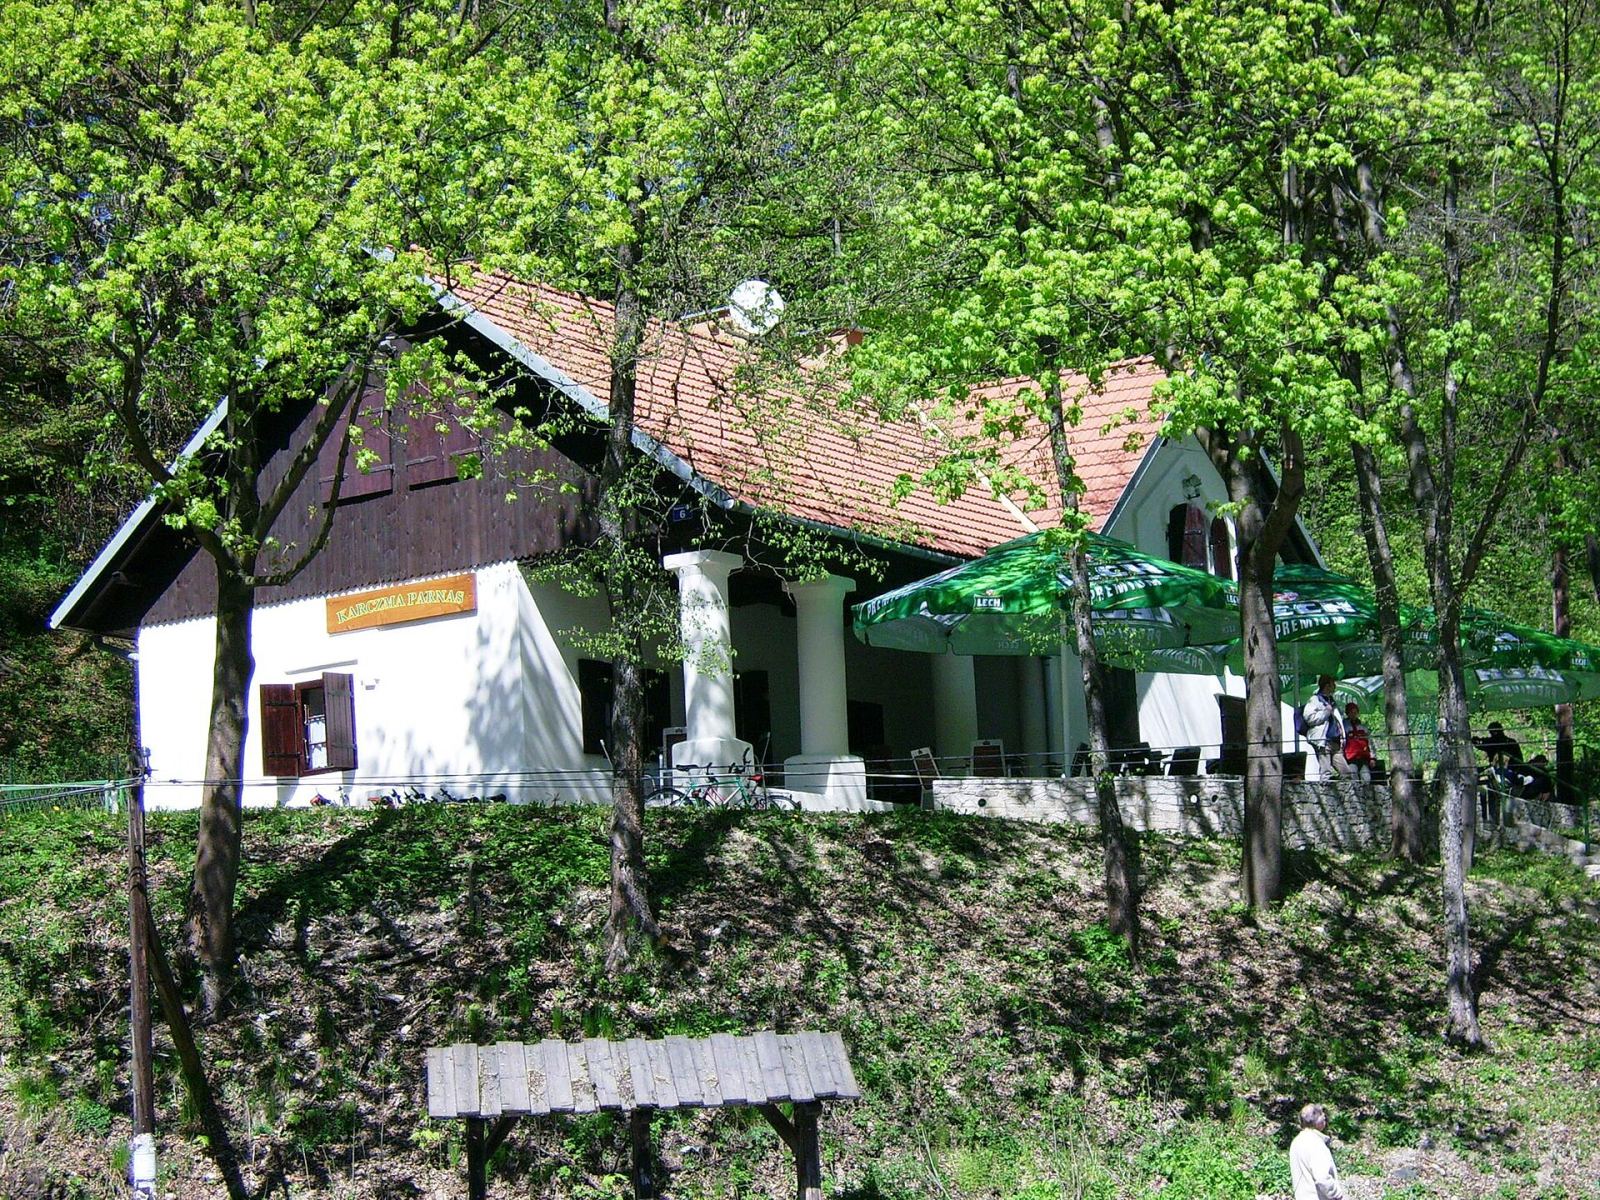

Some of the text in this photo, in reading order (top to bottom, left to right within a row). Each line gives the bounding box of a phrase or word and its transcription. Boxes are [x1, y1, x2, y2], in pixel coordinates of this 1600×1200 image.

[679, 509, 686, 519] 6
[337, 590, 465, 624] KARCZMA PARNAS
[977, 597, 1002, 608] LECH
[1274, 600, 1357, 616] ECH
[1275, 616, 1347, 640] PREMIUM
